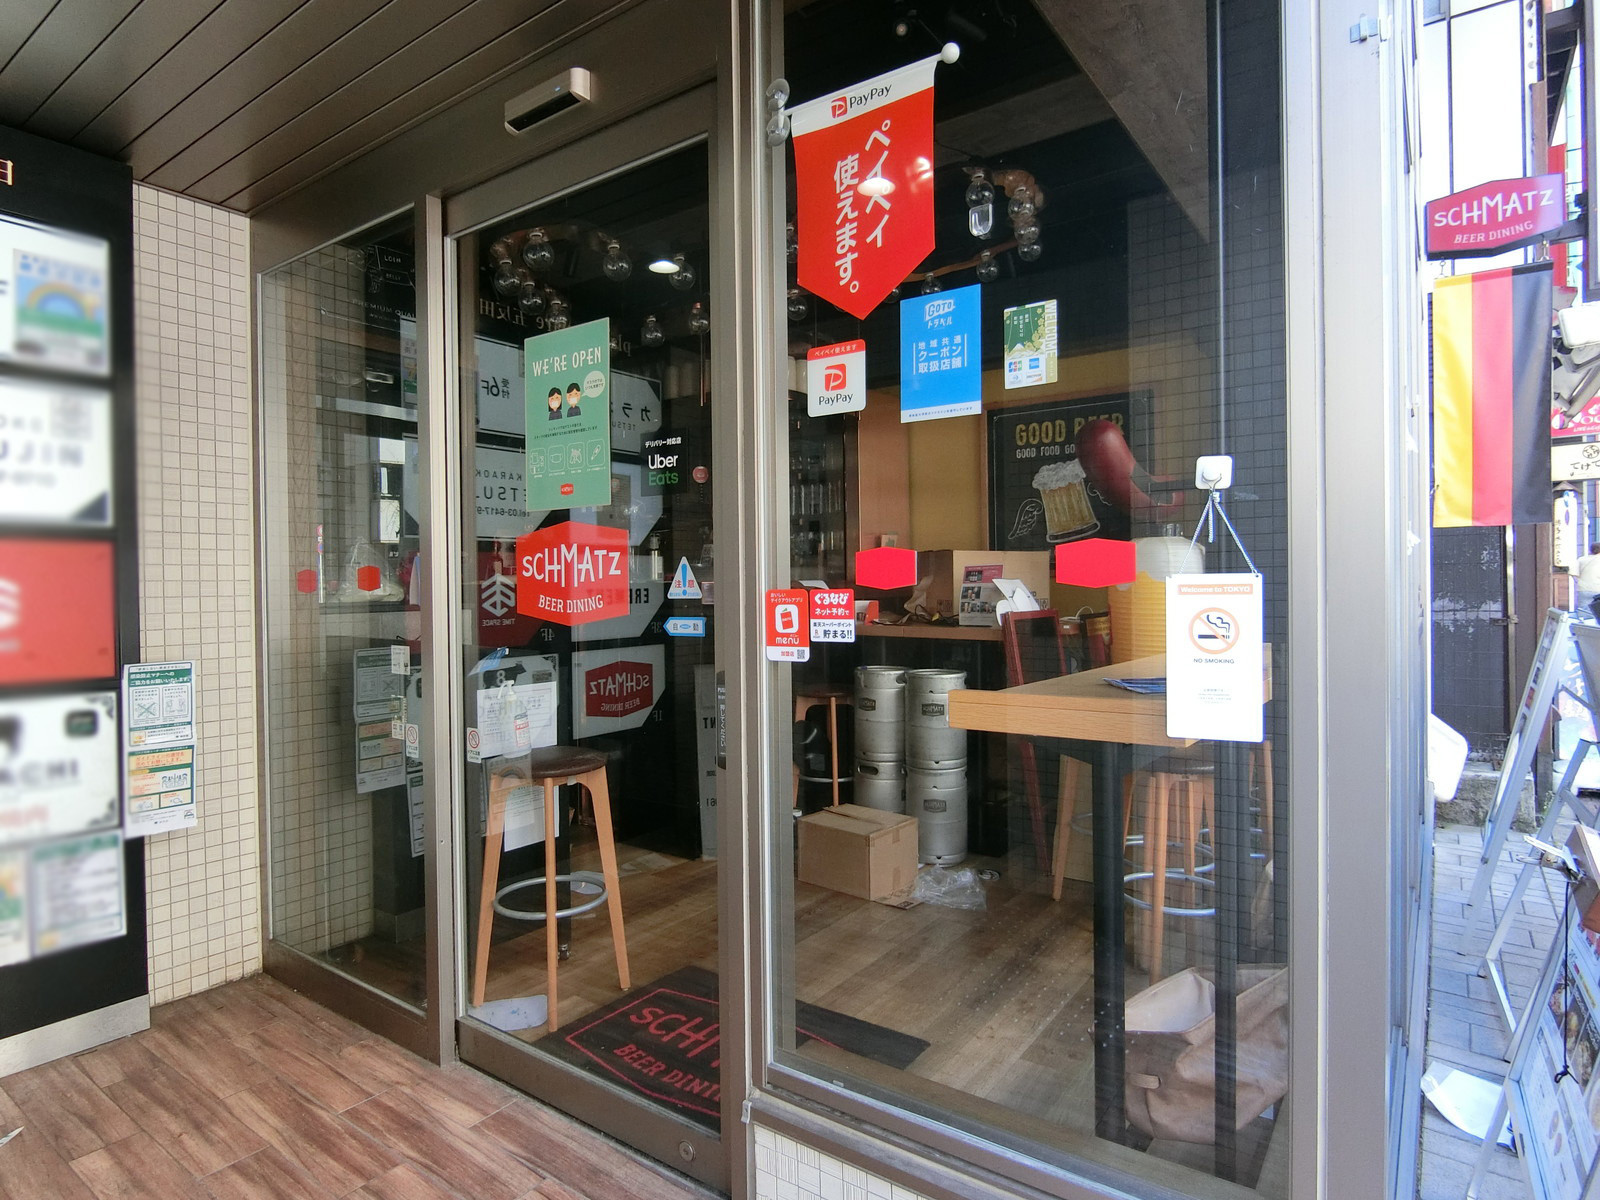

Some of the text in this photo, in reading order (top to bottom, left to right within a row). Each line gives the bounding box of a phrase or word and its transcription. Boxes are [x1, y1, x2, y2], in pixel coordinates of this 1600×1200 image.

[850, 84, 892, 109] PayPay
[865, 119, 892, 248] ペイペイ
[1434, 189, 1554, 227] SCHMATZ
[834, 153, 859, 293] 使えます。
[1454, 220, 1533, 244] BEER DINING
[532, 346, 601, 377] WE'RE OPEN
[918, 346, 962, 361] クーポン
[918, 356, 962, 374] 取扱店舗
[818, 392, 853, 407] PayPay
[1015, 419, 1066, 446] GOOD
[648, 454, 678, 469] Uber
[1016, 448, 1036, 459] GOOD
[1040, 445, 1060, 457] FOOD
[648, 471, 679, 486] Eats
[522, 543, 621, 588] SCHMATZ
[538, 594, 603, 613] BEER DINING
[814, 592, 849, 605] ぐるなび
[815, 608, 849, 616] ネット予約で
[613, 1044, 666, 1077] BEER
